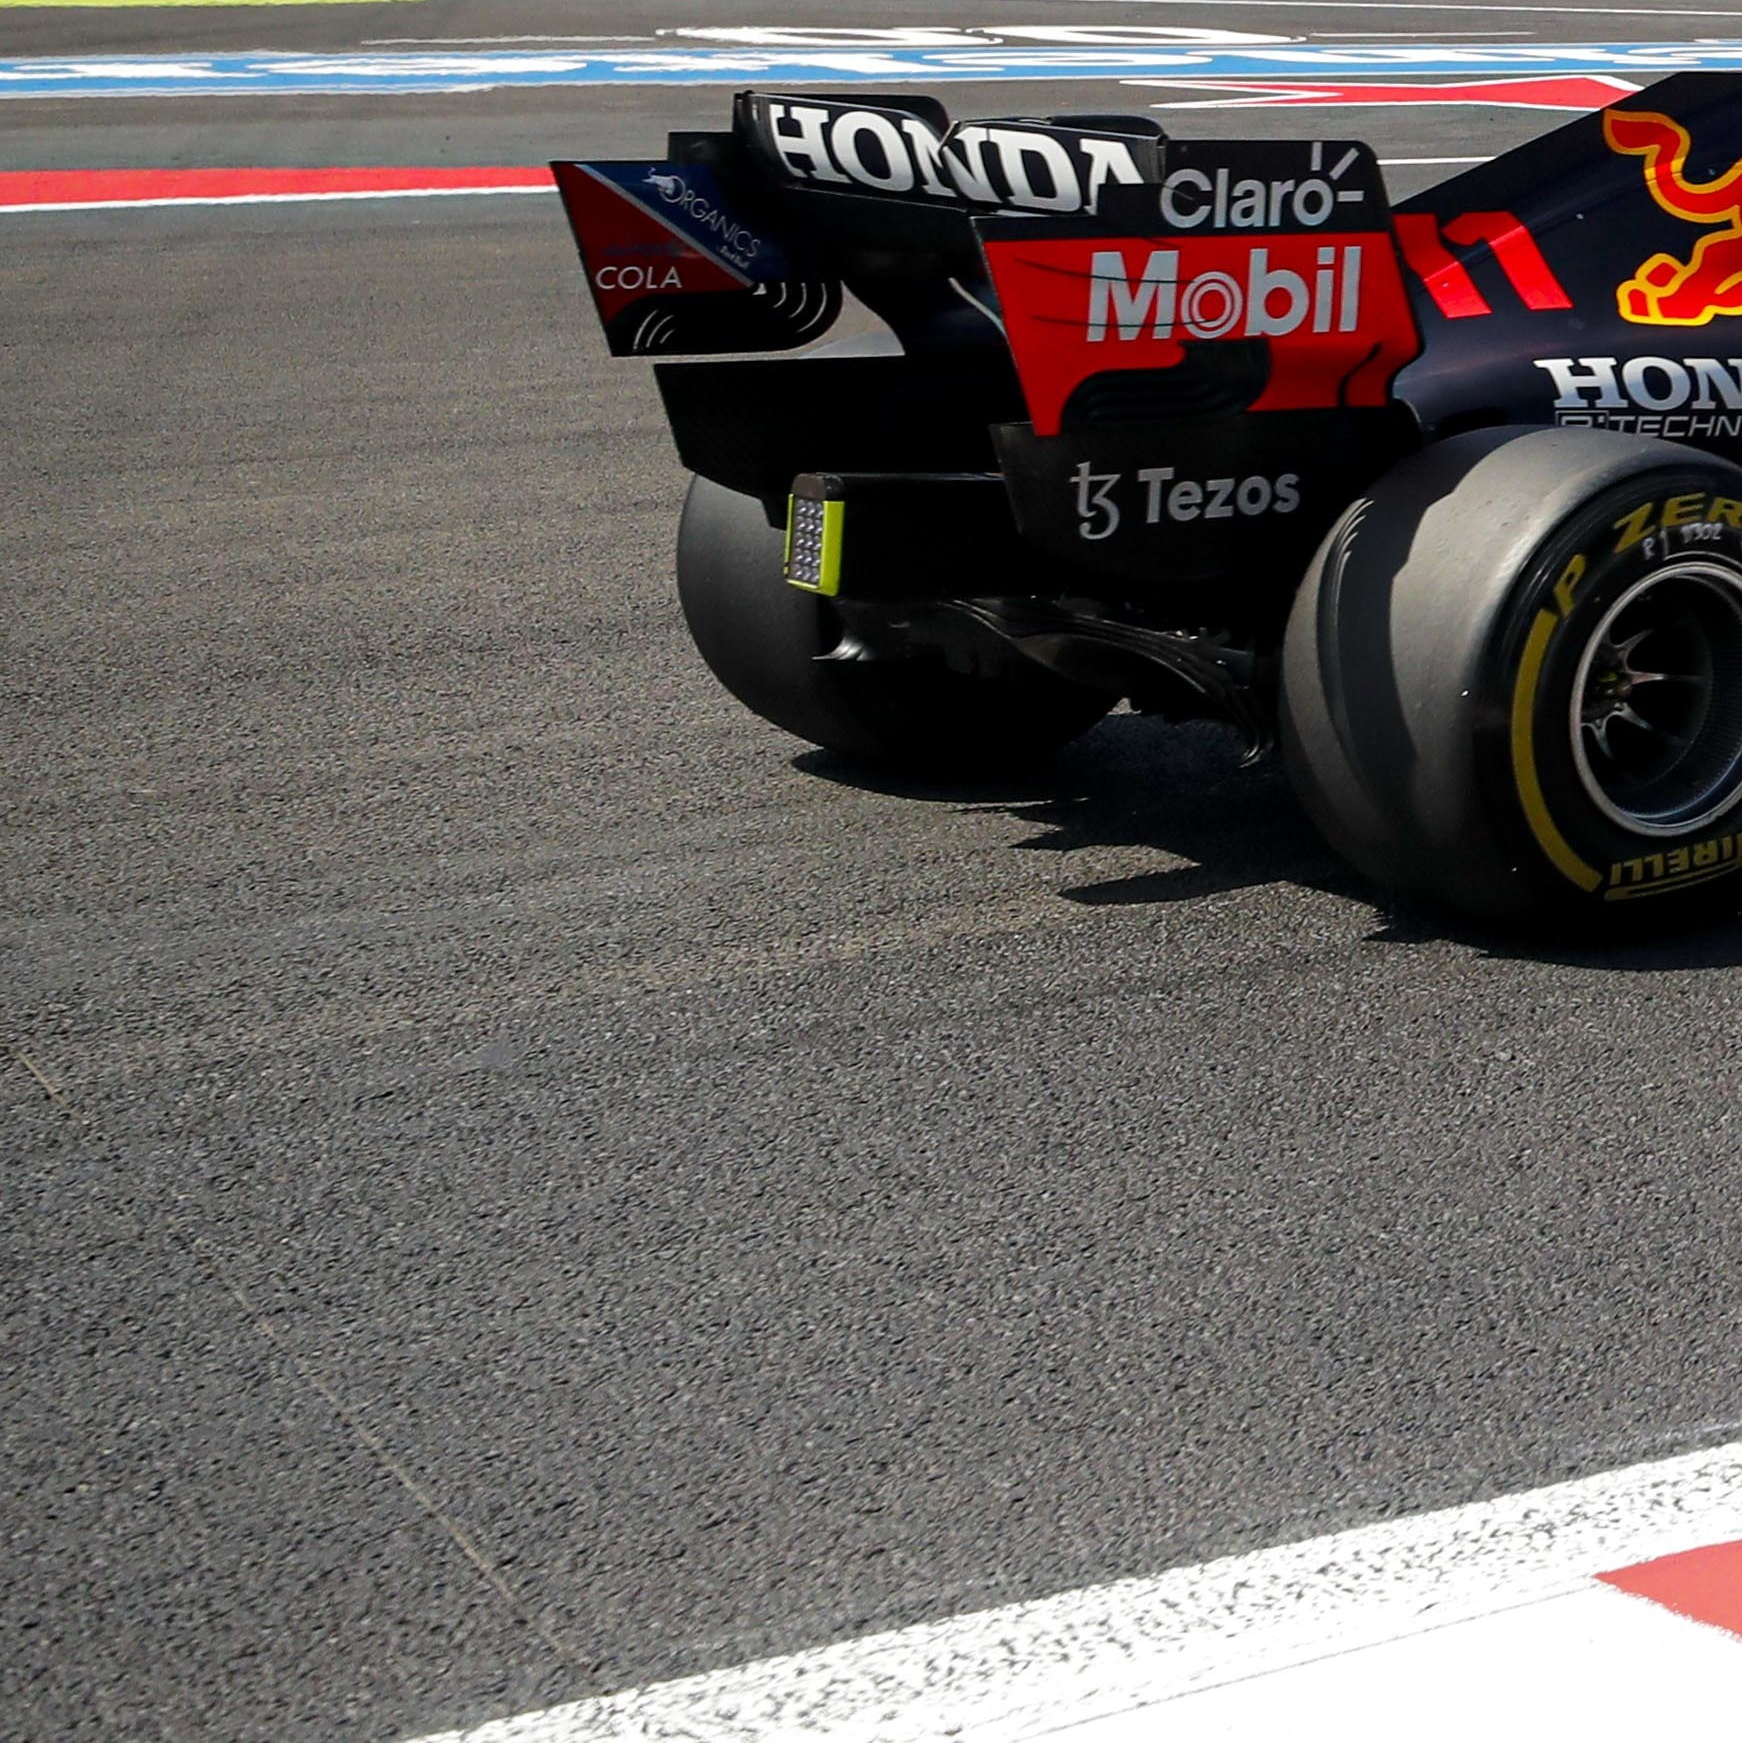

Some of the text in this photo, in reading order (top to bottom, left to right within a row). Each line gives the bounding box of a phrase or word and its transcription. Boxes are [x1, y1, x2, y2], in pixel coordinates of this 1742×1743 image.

[769, 104, 1144, 215] HONDA
[659, 174, 761, 258] ORGANICS
[1161, 168, 1335, 228] Claro
[596, 266, 683, 289] COLA
[1087, 245, 1362, 342] Mobil
[1138, 467, 1301, 523] Tezos
[1553, 554, 1587, 619] P
